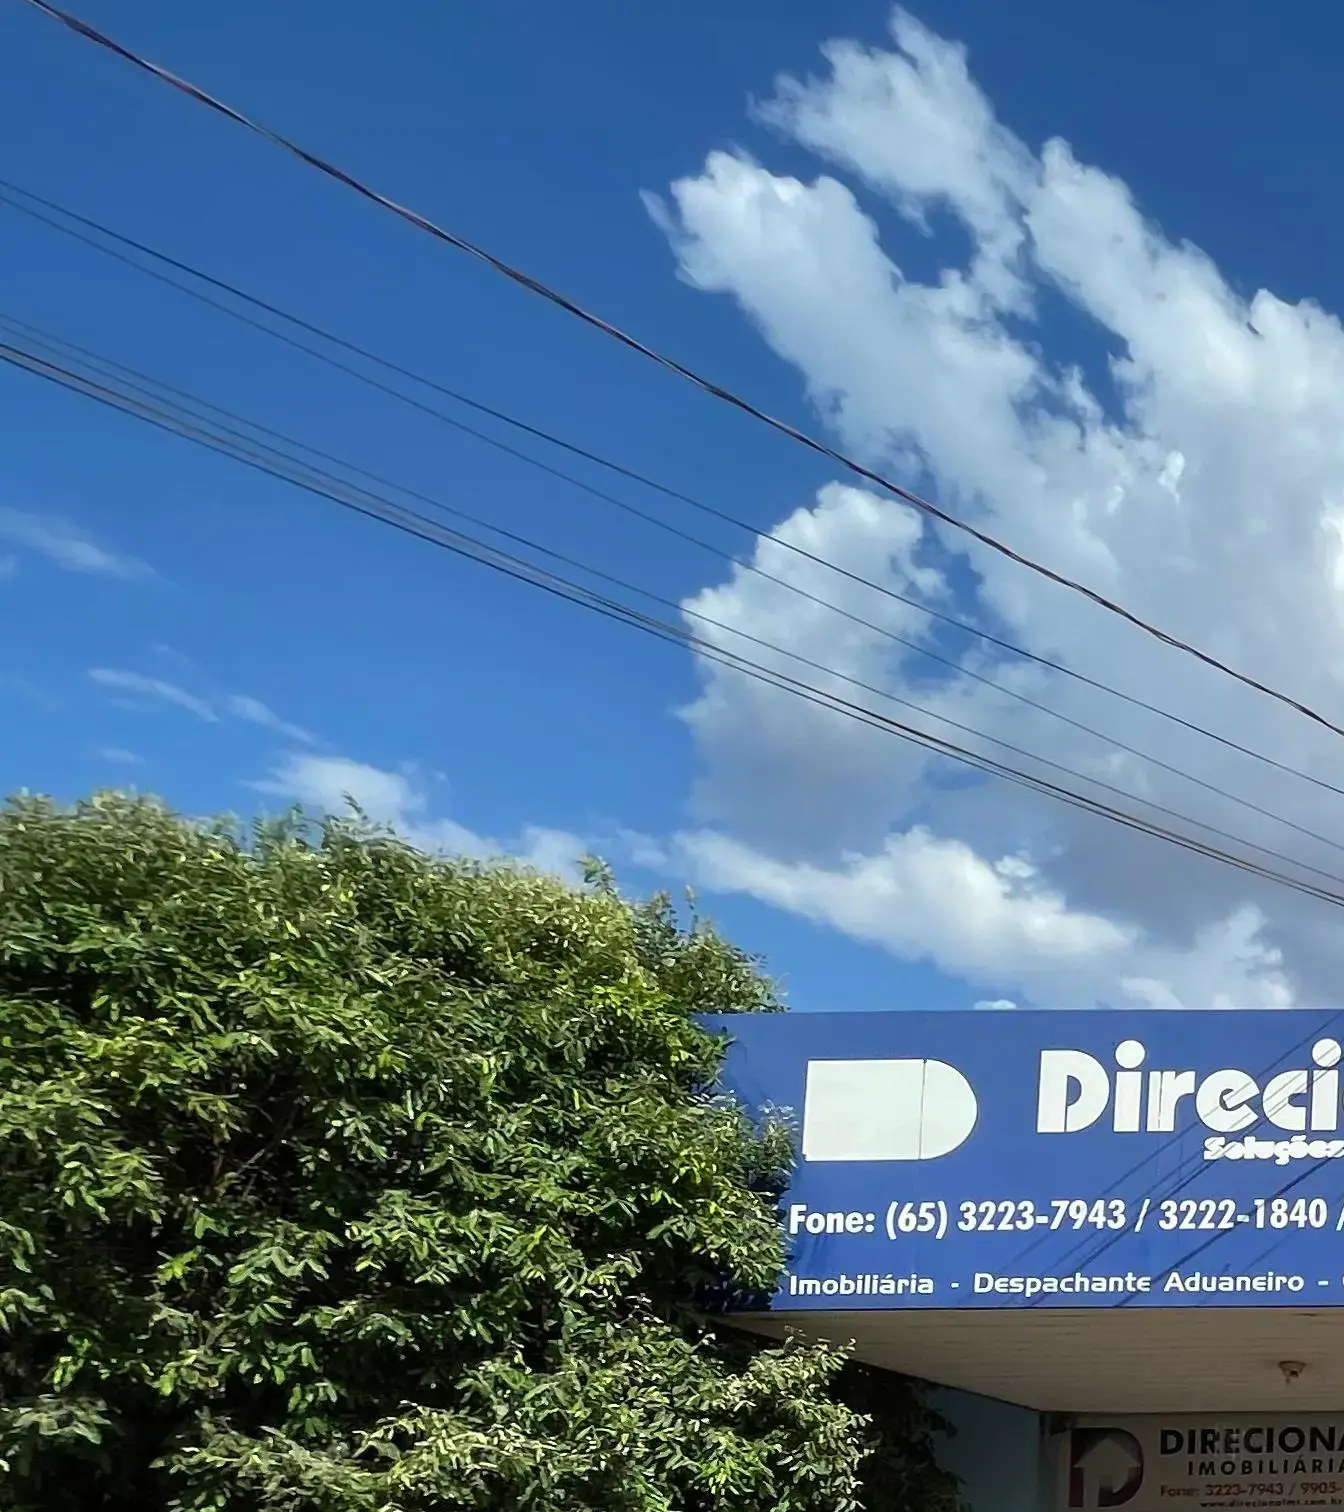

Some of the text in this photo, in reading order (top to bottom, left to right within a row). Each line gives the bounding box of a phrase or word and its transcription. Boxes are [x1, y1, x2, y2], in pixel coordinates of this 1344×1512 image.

[789, 1204, 876, 1236] Fone:
[886, 1200, 949, 1240] (65)
[957, 1198, 1126, 1232] 3223-7943
[1134, 1197, 1151, 1234] /
[1158, 1198, 1328, 1230] 3222-1840
[789, 1274, 935, 1297] Imobiliária
[973, 1272, 1151, 1298] Despachante
[1163, 1271, 1306, 1293] Aduaneiro
[1204, 1481, 1284, 1497] 3223-7943
